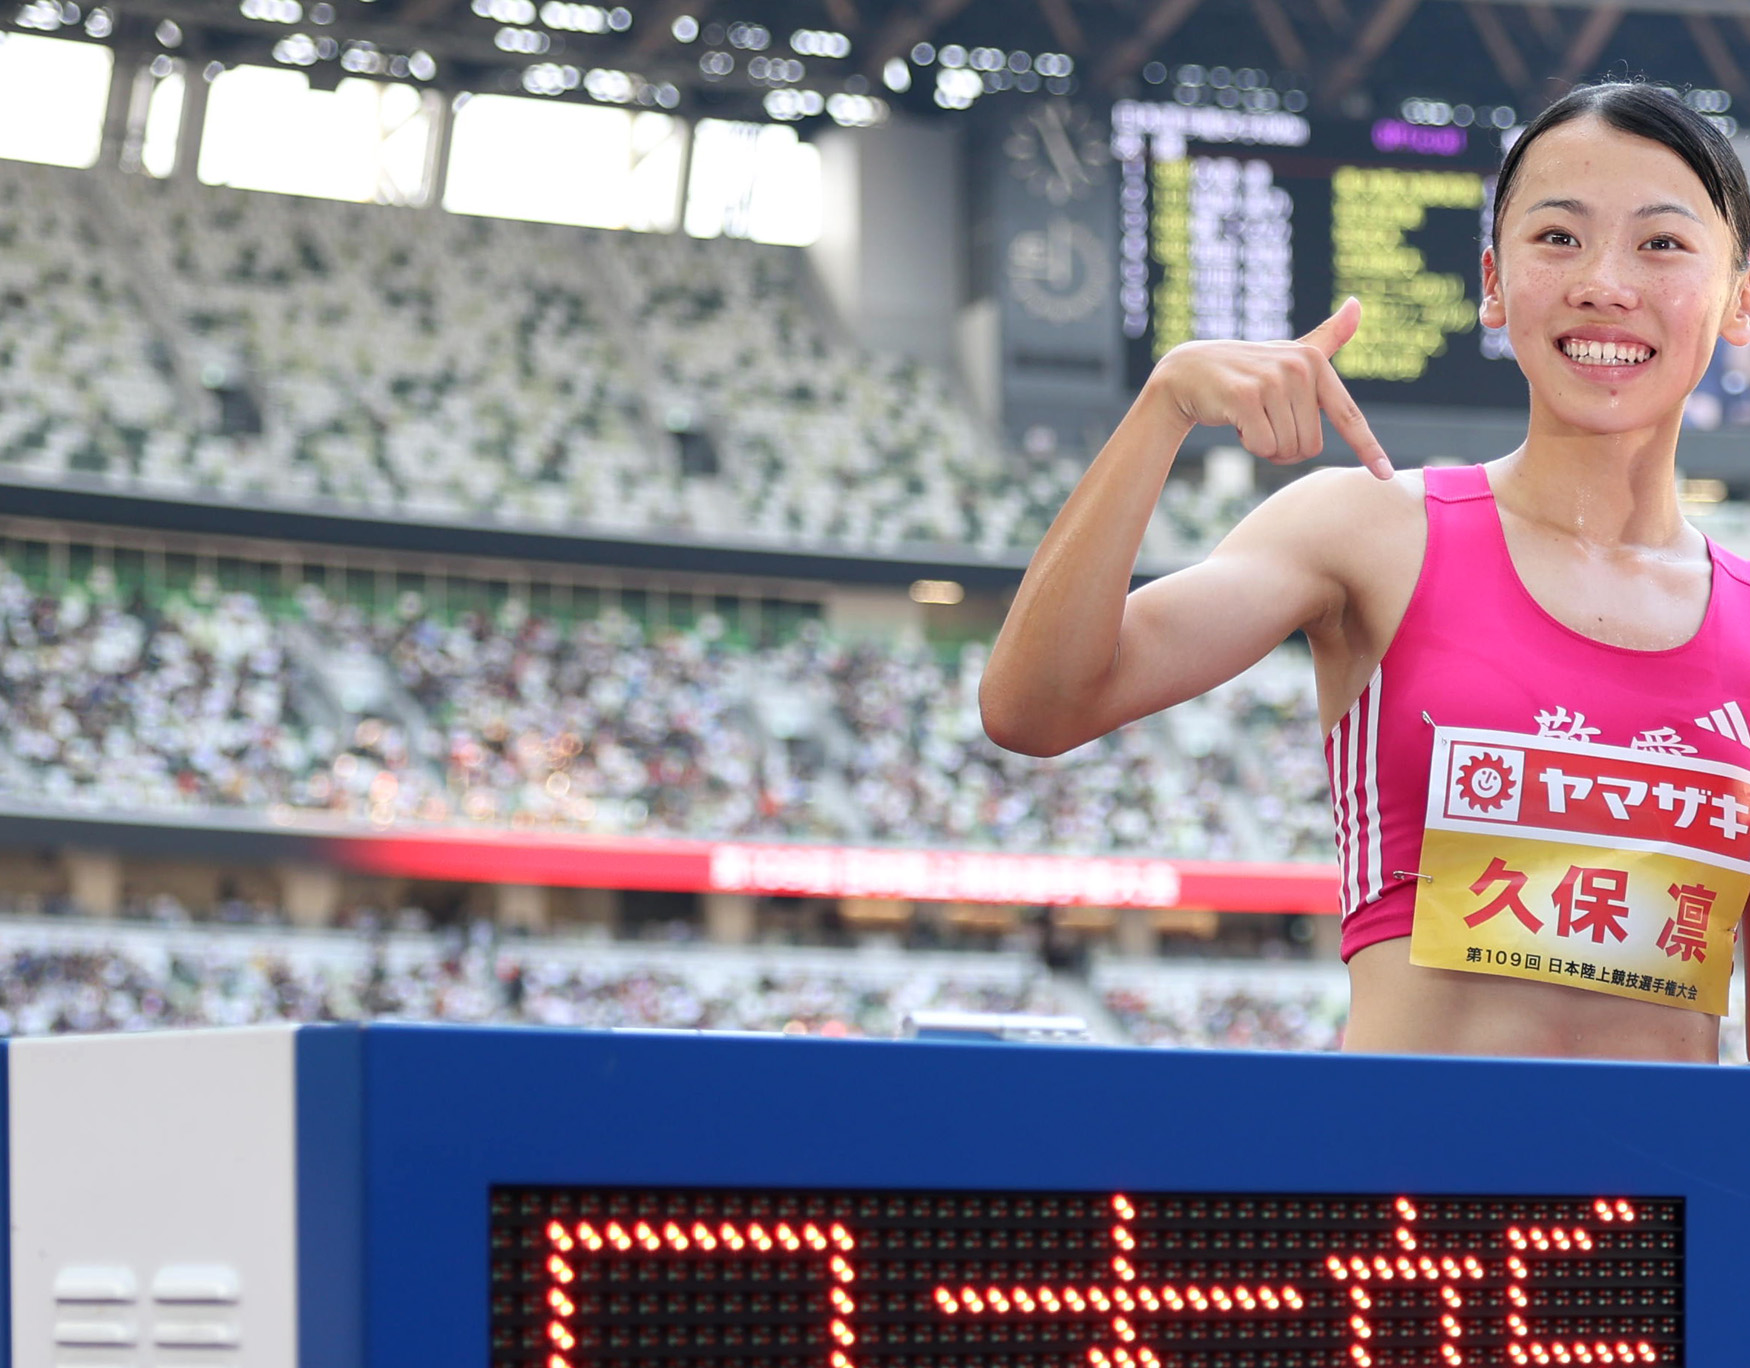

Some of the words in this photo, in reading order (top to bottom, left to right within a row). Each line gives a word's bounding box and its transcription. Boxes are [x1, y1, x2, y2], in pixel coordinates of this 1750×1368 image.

[1538, 767, 1750, 841] ヤマザキ
[1462, 856, 1631, 944] 久保
[1655, 882, 1718, 965] 凛
[1465, 946, 1542, 972] 第109回
[1548, 957, 1698, 1001] 日本陸上競技選手権大会
